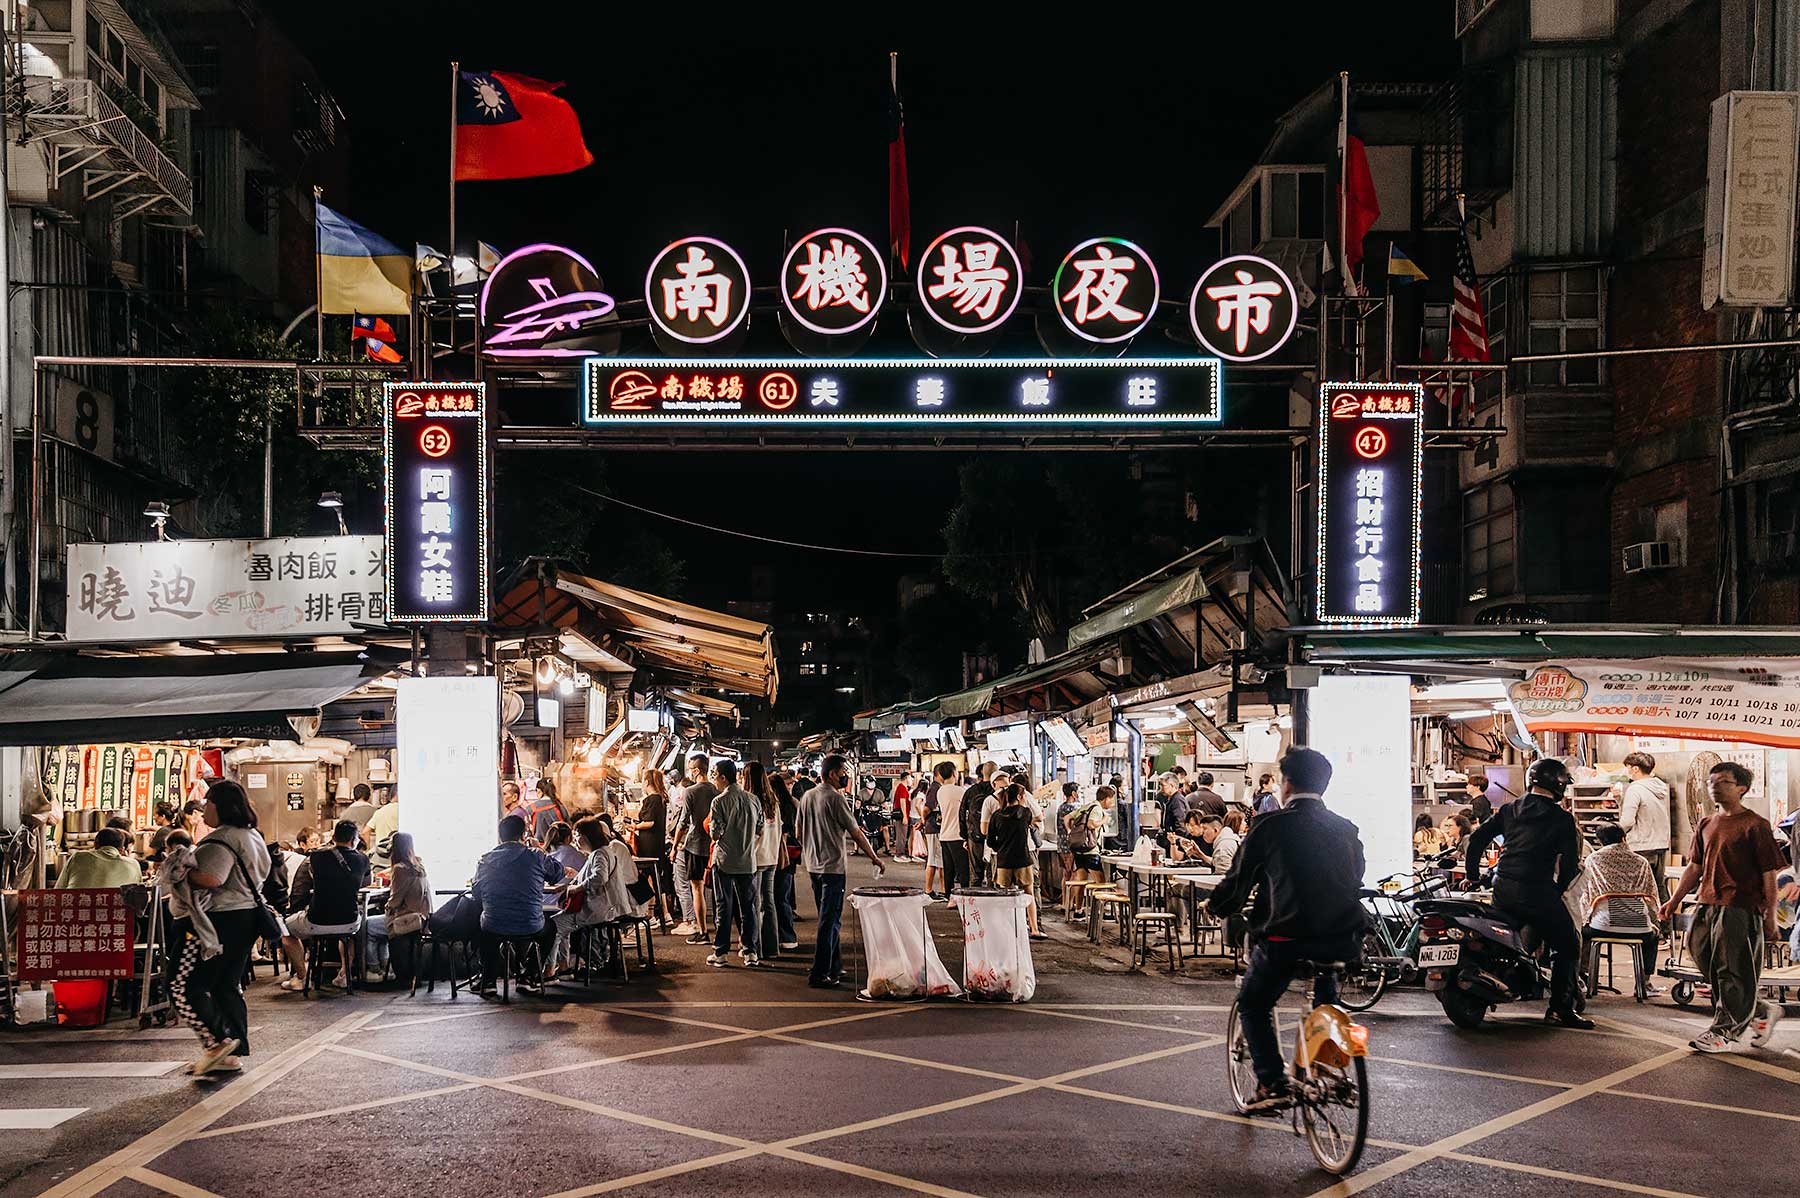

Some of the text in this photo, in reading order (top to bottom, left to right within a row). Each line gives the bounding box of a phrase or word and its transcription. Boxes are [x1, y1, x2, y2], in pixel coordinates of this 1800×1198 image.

[659, 238, 1281, 353] 南機場夜市
[661, 375, 743, 401] 南機場
[764, 381, 791, 401] 61
[425, 395, 475, 411] 南機場
[1361, 397, 1413, 413] 南機場
[425, 435, 446, 449] 52
[1360, 435, 1382, 450] 47
[1679, 697, 1703, 706] 10/4
[1710, 698, 1740, 708] 10/11
[1746, 700, 1778, 711] 10/18
[1675, 710, 1699, 719] 10/7
[1706, 712, 1736, 721] 10/14
[1743, 714, 1774, 726] 10/21
[25, 924, 126, 937] 請勿於此處停車
